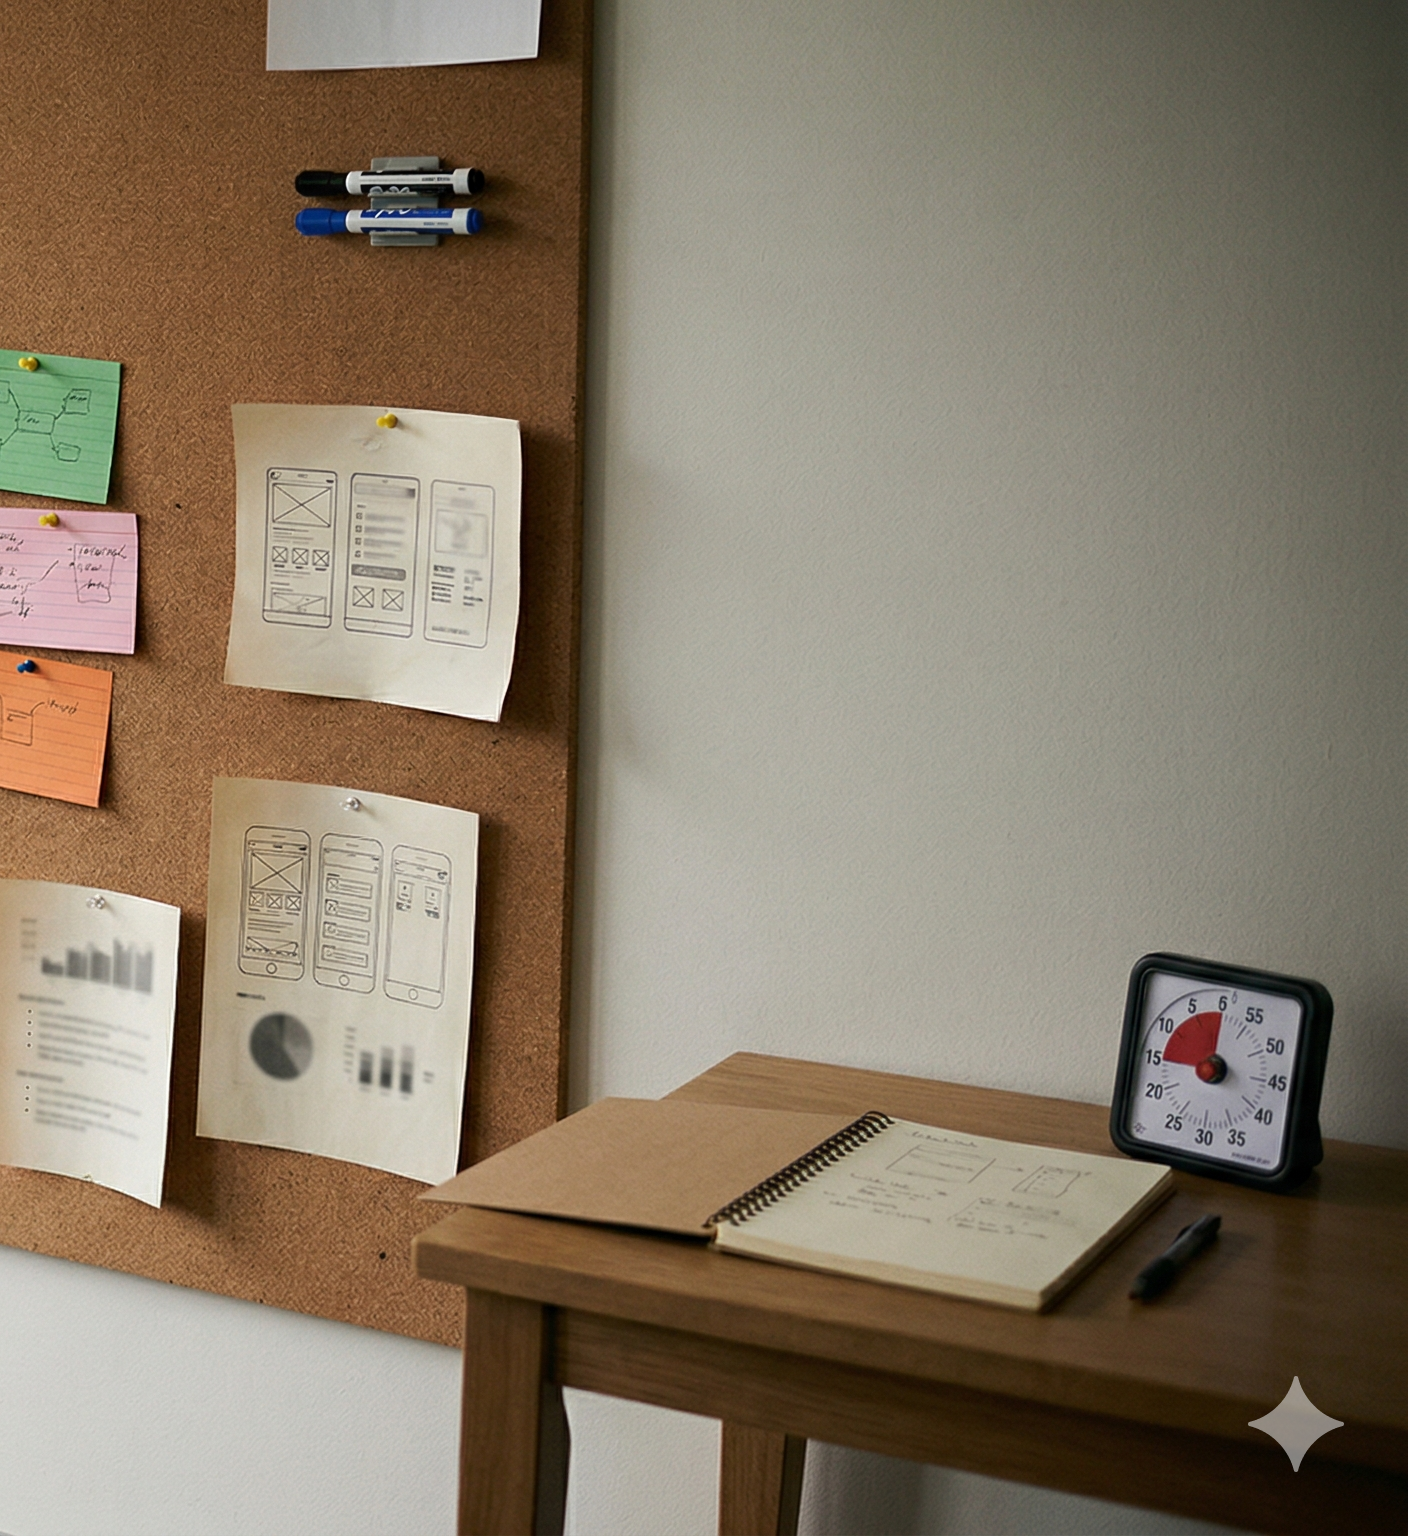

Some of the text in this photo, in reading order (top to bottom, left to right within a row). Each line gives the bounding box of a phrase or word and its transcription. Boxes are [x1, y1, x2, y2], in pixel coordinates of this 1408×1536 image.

[1188, 998, 1197, 1013] 5
[1218, 996, 1227, 1011] 6
[1245, 1007, 1264, 1024] 55
[1159, 1017, 1174, 1034] 10
[1266, 1038, 1284, 1055] 50
[1146, 1049, 1162, 1065] 15
[1145, 1083, 1163, 1100] 20
[1268, 1074, 1287, 1092] 45
[1165, 1113, 1183, 1132] 25
[1254, 1107, 1273, 1126] 40
[1194, 1128, 1213, 1146] 30
[1227, 1128, 1246, 1147] 35
